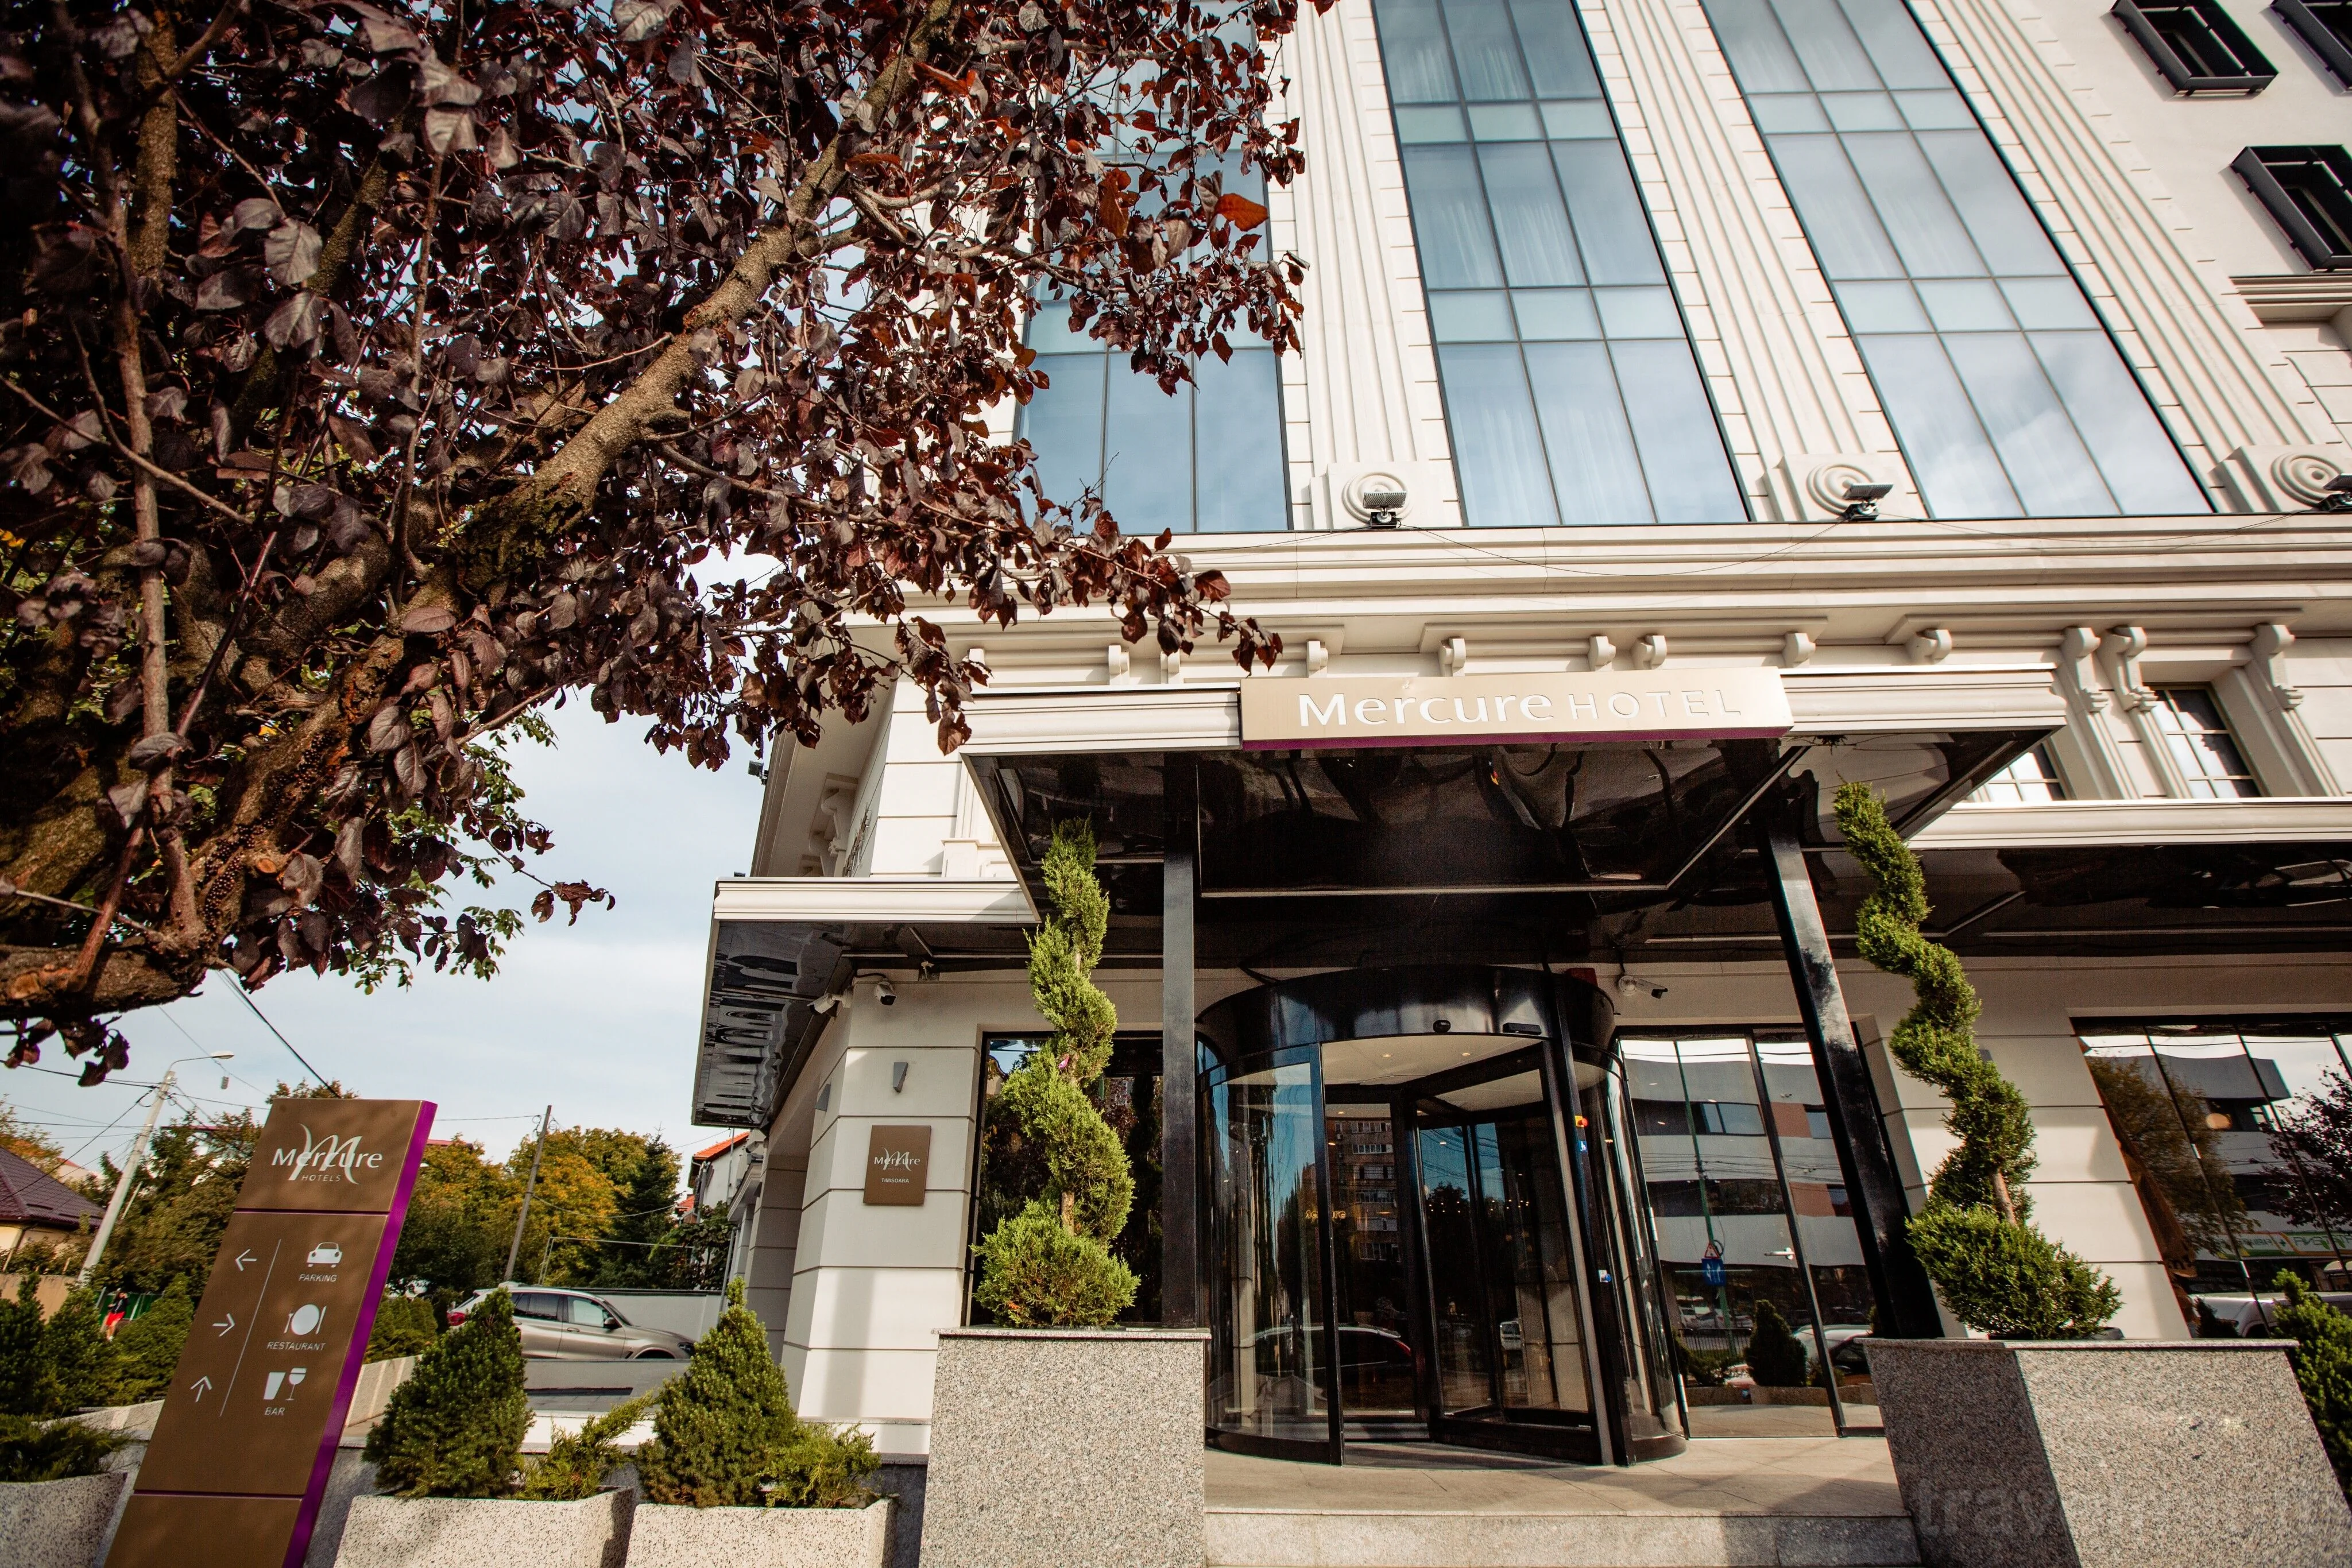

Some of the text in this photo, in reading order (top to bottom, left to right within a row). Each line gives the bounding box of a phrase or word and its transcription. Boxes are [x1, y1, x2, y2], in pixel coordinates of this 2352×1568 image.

[1299, 690, 1742, 726] Mercure HOTEL
[271, 1148, 383, 1168] Mercure
[874, 1157, 920, 1165] Mercure
[301, 1174, 342, 1182] HOTELS
[299, 1273, 338, 1282] PARKING
[266, 1341, 326, 1350] RESTAURANT
[264, 1407, 285, 1416] BAR
